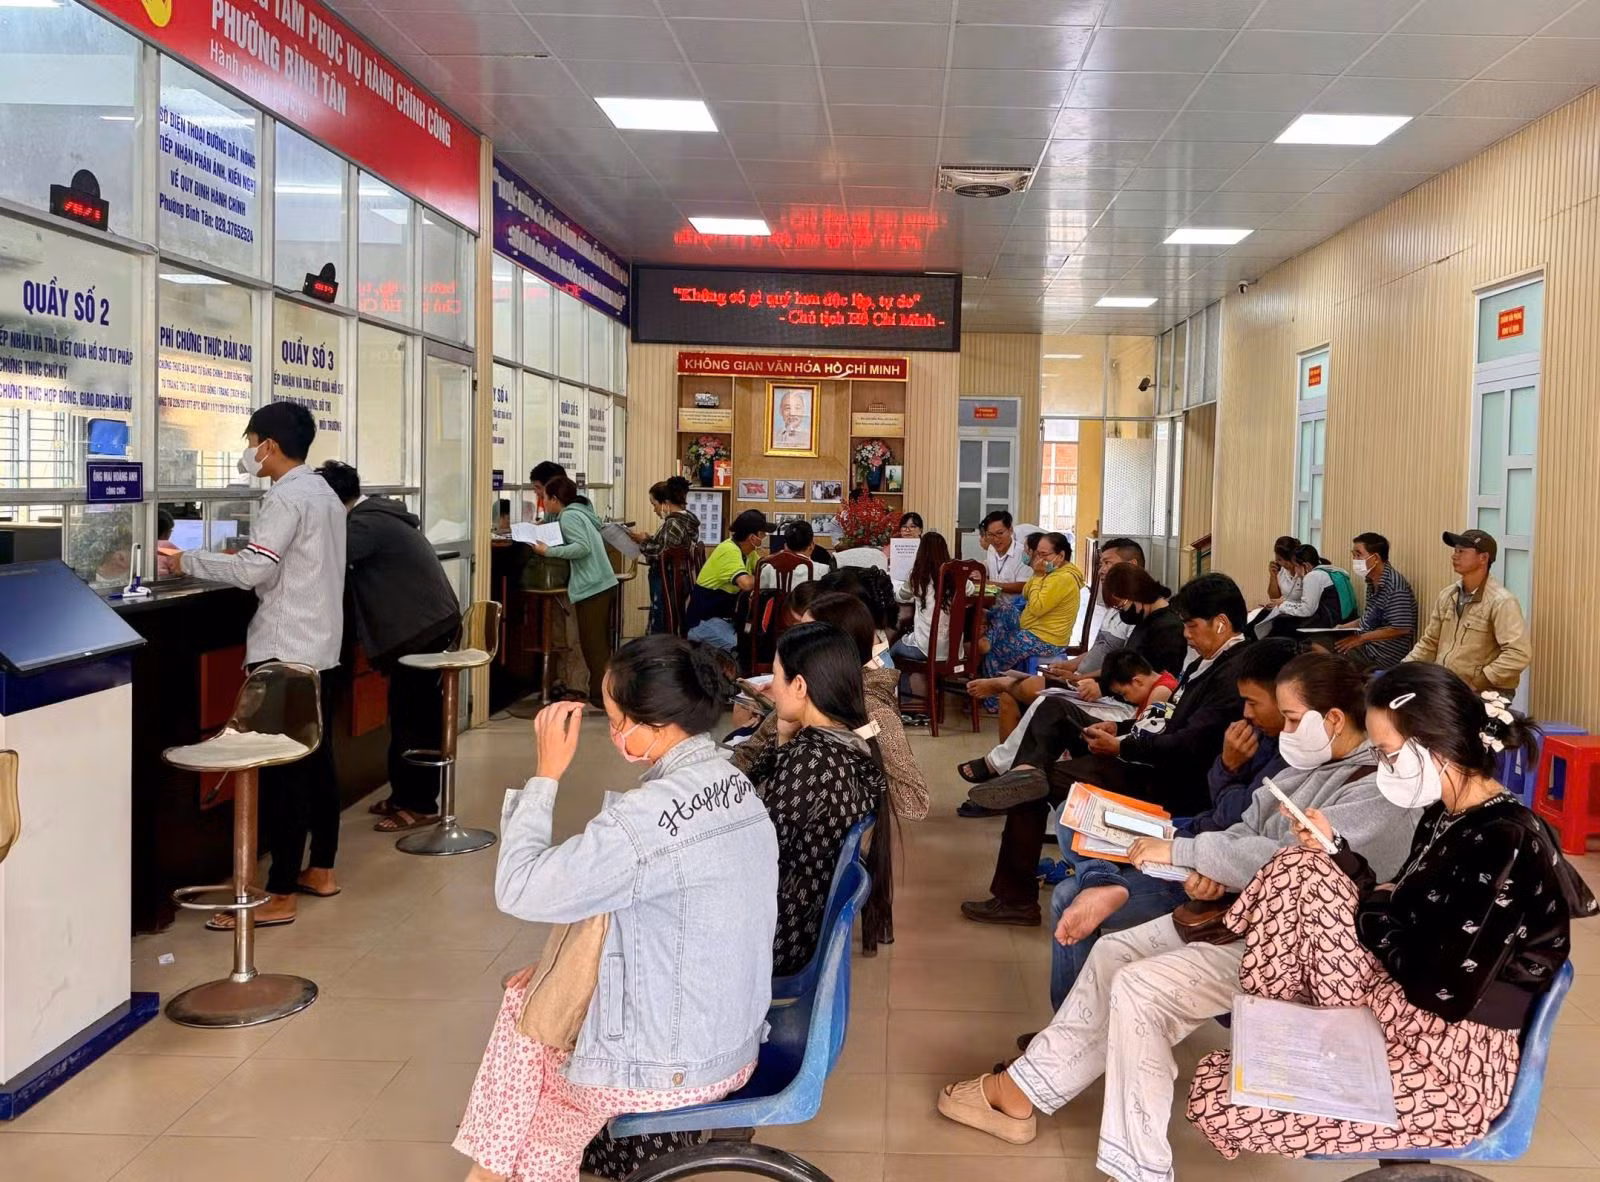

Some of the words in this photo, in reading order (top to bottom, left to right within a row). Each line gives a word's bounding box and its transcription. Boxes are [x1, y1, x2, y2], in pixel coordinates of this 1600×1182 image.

[210, 39, 239, 76] Hành
[212, 0, 280, 73] PHƯỜNG
[284, 44, 319, 97] BÌNH
[321, 72, 347, 117] TÂN
[308, 11, 343, 66] PHỤC
[346, 42, 362, 86] VỤ
[364, 57, 394, 105] HÀNH
[396, 82, 426, 129] CHÍNH
[427, 107, 451, 148] CÔNG
[169, 112, 186, 136] ĐIỆN
[187, 121, 206, 146] THOẠI
[174, 143, 193, 166] NHẬN
[159, 192, 184, 219] Phường
[185, 203, 200, 224] Bình
[180, 174, 194, 193] QUY
[194, 181, 210, 201] ĐỊNH
[228, 196, 246, 217] CHÍNH
[23, 276, 69, 318] QUẦY
[74, 285, 96, 323] SỐ
[100, 298, 110, 326] 2
[10, 329, 32, 353] NHẬN
[60, 336, 72, 357] KẾT
[160, 324, 174, 348] PHÍ
[176, 328, 202, 353] CHỨNG
[203, 335, 222, 360] THỰC
[223, 334, 238, 360] BẢN
[239, 343, 252, 362] SAO
[281, 336, 309, 366] QUẦY
[312, 342, 326, 369] SỐ
[328, 351, 334, 371] 3
[685, 357, 730, 370] KHÔNG
[733, 360, 763, 371] GIAN
[767, 359, 792, 372] VĂN
[794, 360, 821, 373] HÓA
[845, 362, 866, 375] CHÍ
[869, 364, 900, 375] MINH
